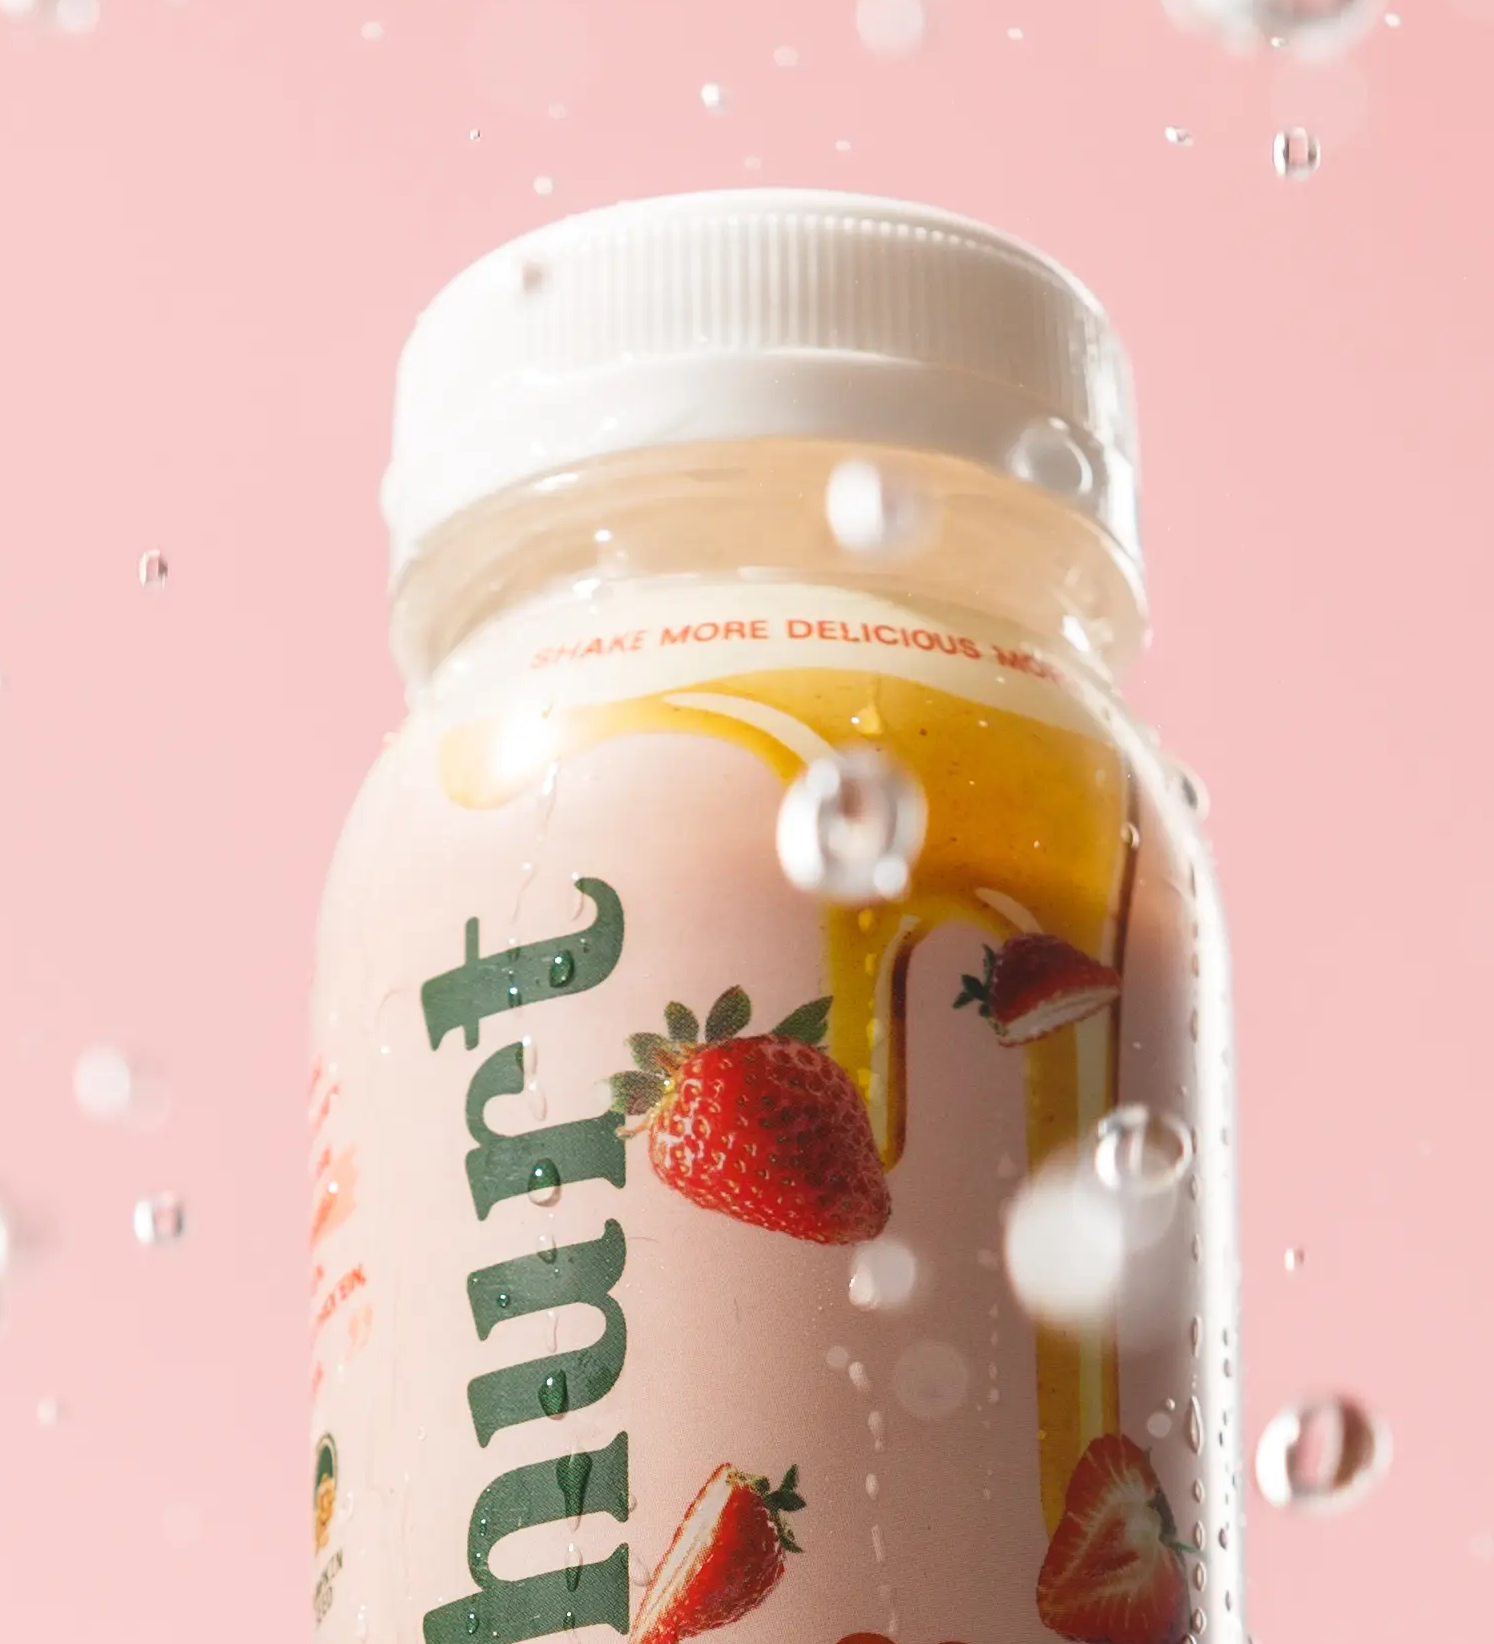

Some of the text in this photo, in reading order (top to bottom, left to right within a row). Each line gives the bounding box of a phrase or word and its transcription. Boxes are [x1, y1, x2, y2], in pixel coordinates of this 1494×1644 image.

[531, 629, 650, 670] SHAKE
[660, 618, 770, 650] MORE
[786, 618, 982, 660] DELICIOUS
